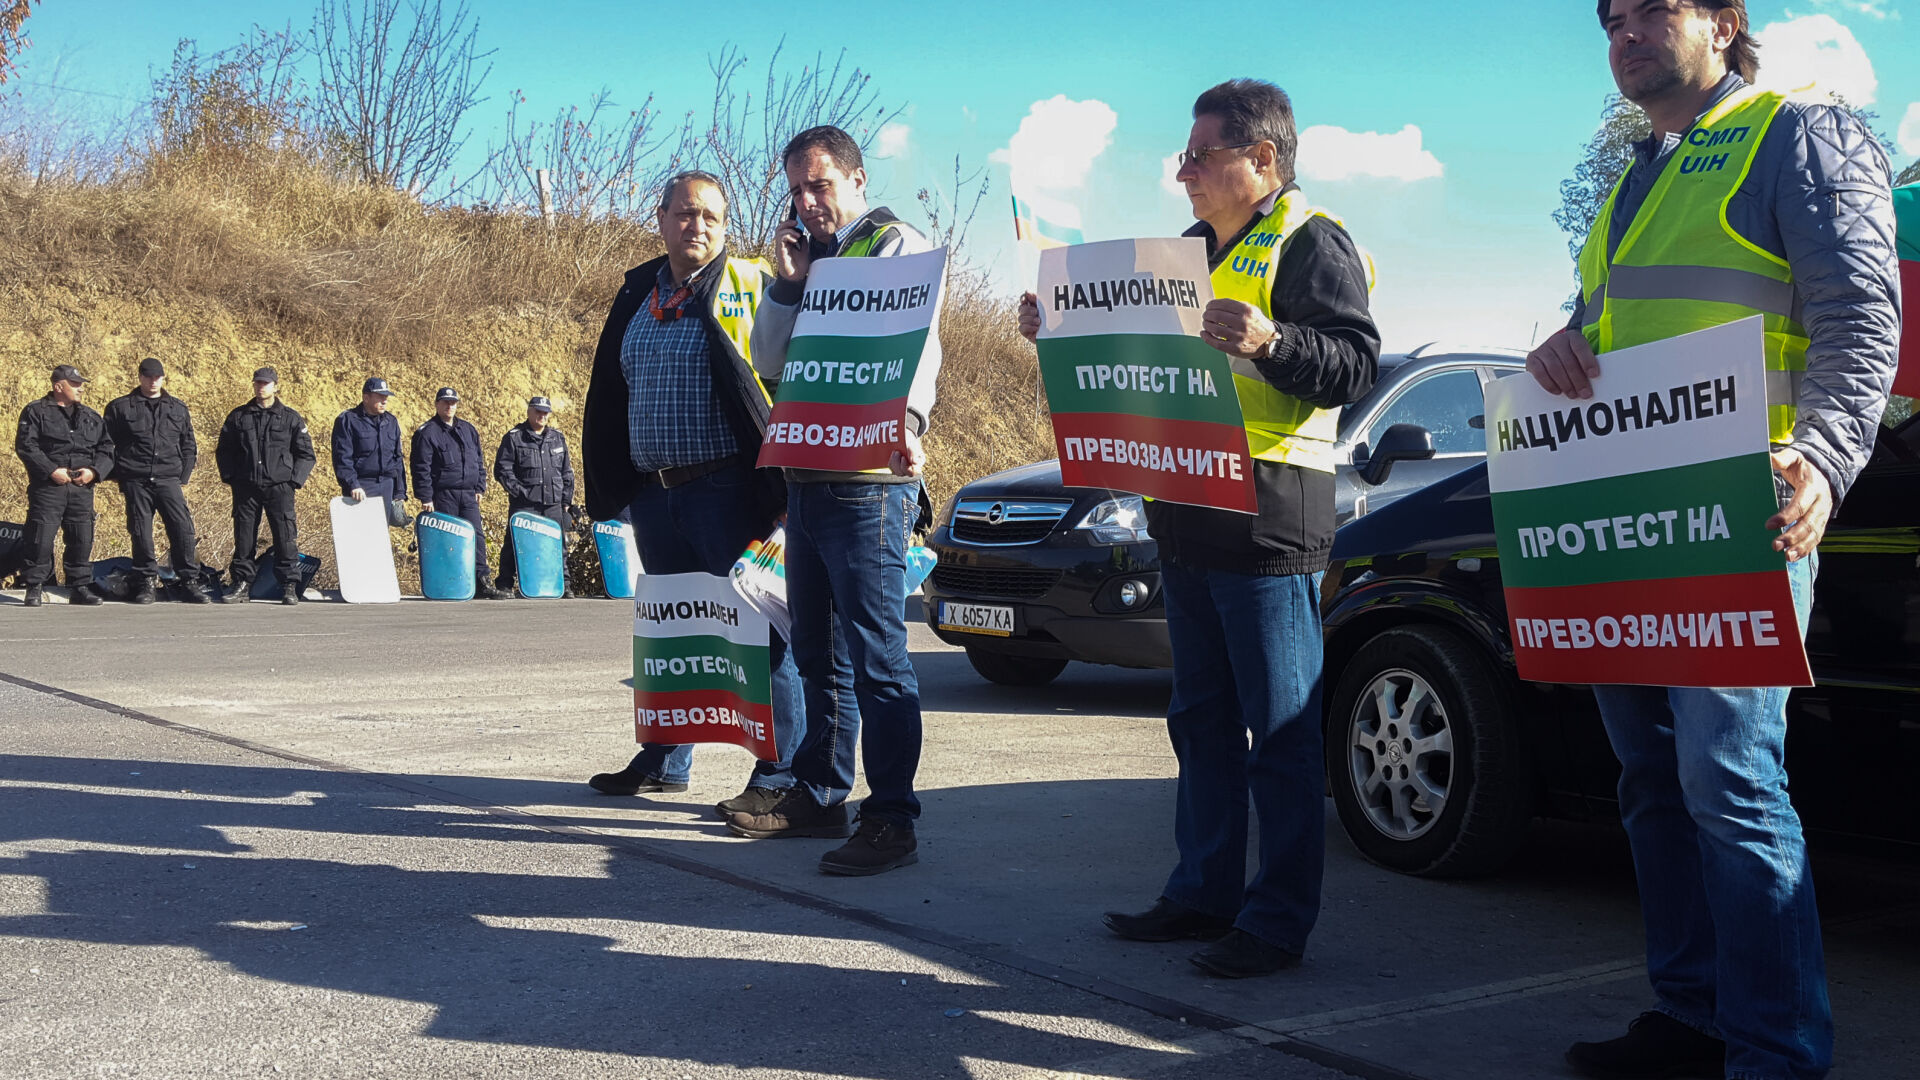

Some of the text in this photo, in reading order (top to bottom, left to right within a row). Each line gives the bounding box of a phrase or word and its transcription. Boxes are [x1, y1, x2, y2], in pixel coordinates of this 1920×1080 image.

[1688, 126, 1751, 147] СМП
[799, 283, 931, 315] АЦИОНАЛЕН
[1054, 278, 1200, 312] НАЦИОНАЛЕН
[782, 358, 904, 385] ПРОТЕСТ НА
[1075, 364, 1218, 397] ПРОТЕСТ НА
[1497, 375, 1737, 452] НАЦИОНАЛЕН
[1064, 437, 1244, 481] ПРЕВОЗВАЧИТЕ
[1517, 504, 1731, 558] ПРОТЕСТ НА
[636, 600, 739, 627] НАЦИОНАЛЕН
[949, 604, 1012, 630] X 6057 KA
[1515, 610, 1780, 649] ПРЕВОЗВАЧИТЕ
[643, 656, 747, 685] ПРОТЕСТ НА
[637, 706, 766, 741] ПРЕВОЗВАЧИТЕ
